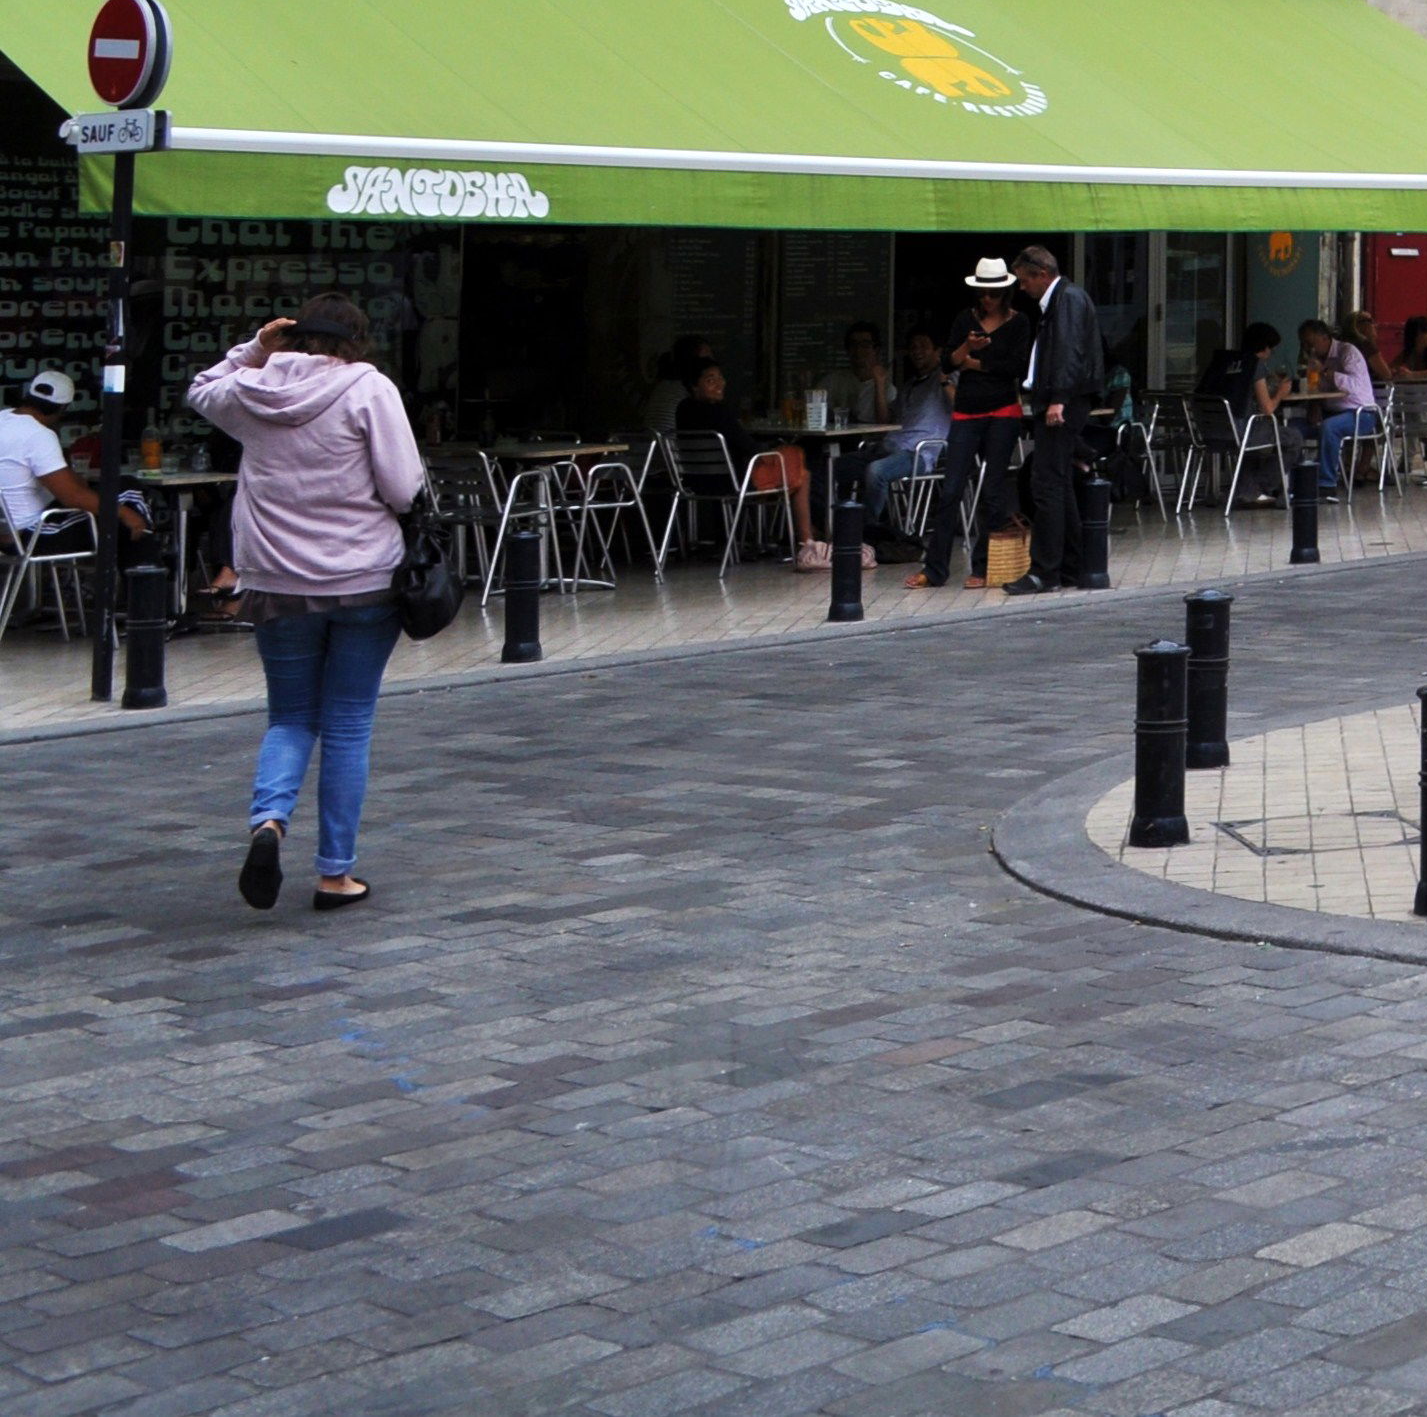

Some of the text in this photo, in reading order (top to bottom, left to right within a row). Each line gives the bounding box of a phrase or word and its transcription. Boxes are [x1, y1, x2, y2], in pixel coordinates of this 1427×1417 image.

[82, 124, 114, 143] SAUF
[326, 165, 549, 218] SANTOSHA
[164, 246, 394, 292] Expresso
